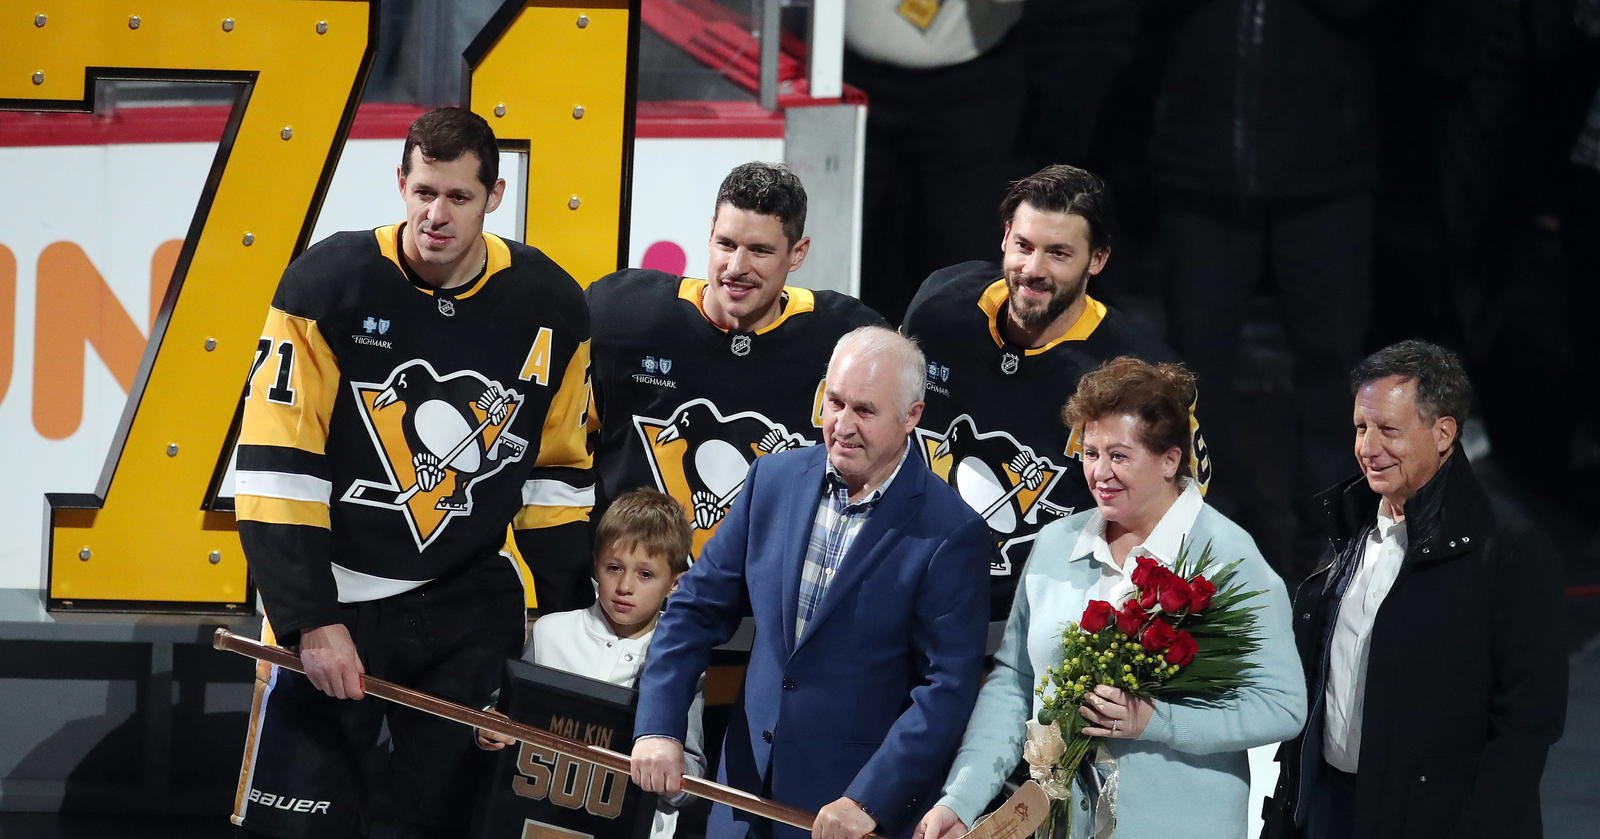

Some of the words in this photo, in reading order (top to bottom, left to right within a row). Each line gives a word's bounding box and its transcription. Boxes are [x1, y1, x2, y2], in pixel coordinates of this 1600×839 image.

[244, 336, 296, 406] 71
[519, 326, 553, 387] A
[633, 374, 677, 389] HIGHMARK
[549, 714, 614, 749] MALKIN
[512, 741, 629, 819] 500
